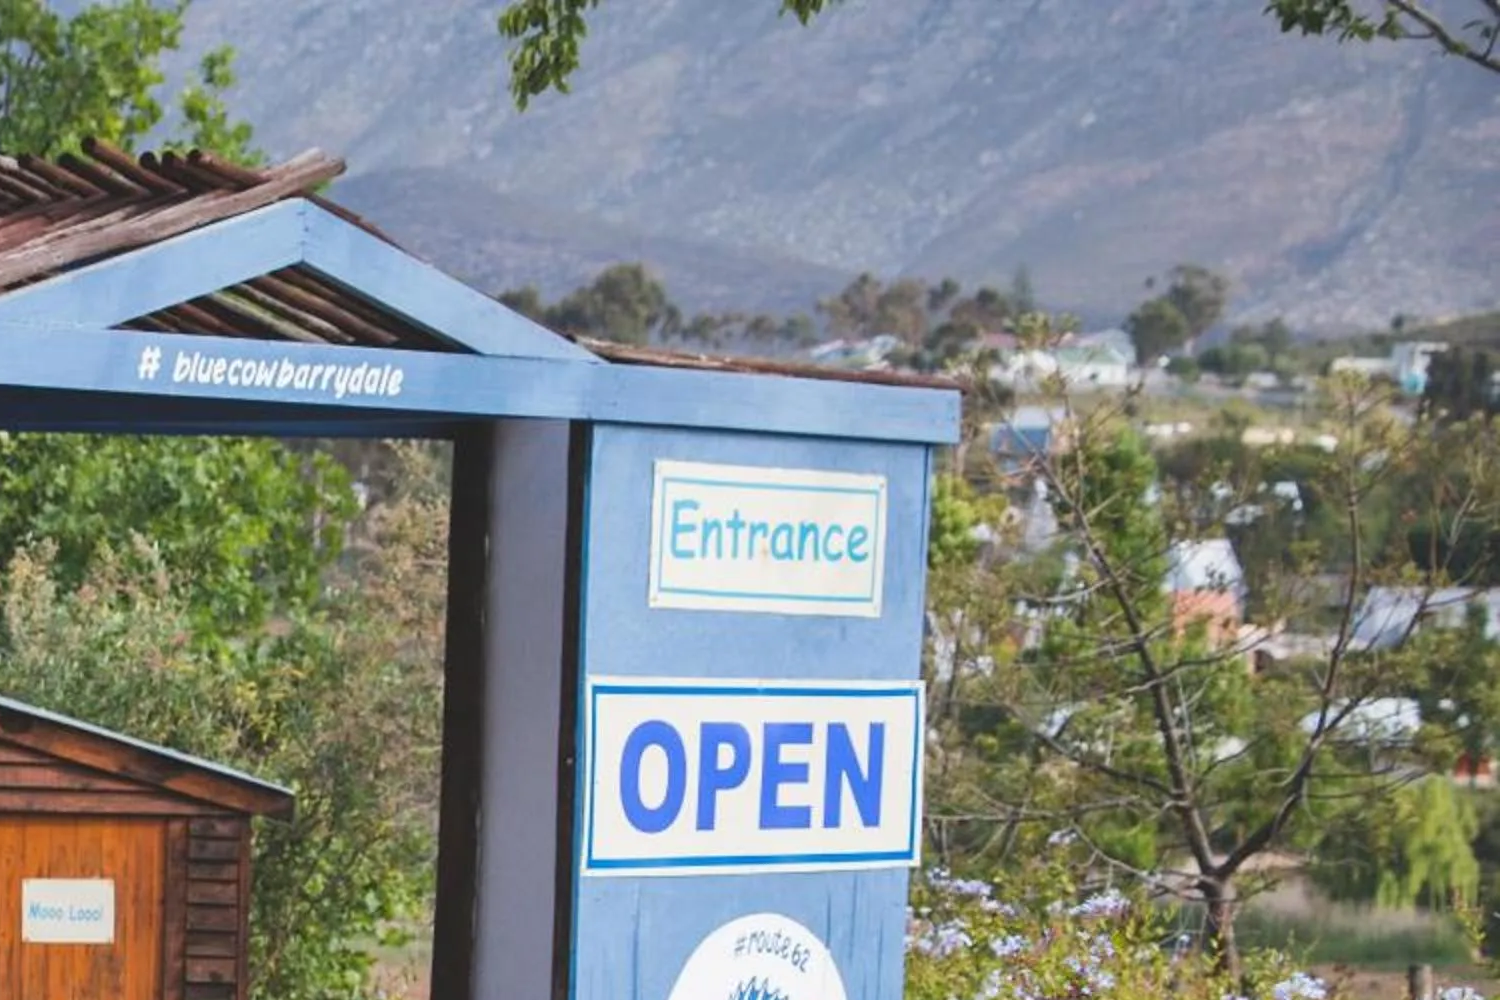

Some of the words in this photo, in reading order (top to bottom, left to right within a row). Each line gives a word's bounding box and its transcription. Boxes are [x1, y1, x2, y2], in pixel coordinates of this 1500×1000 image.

[172, 350, 404, 399] bluecowbarrydale
[669, 499, 870, 563] Entrance
[619, 719, 886, 834] OPEN
